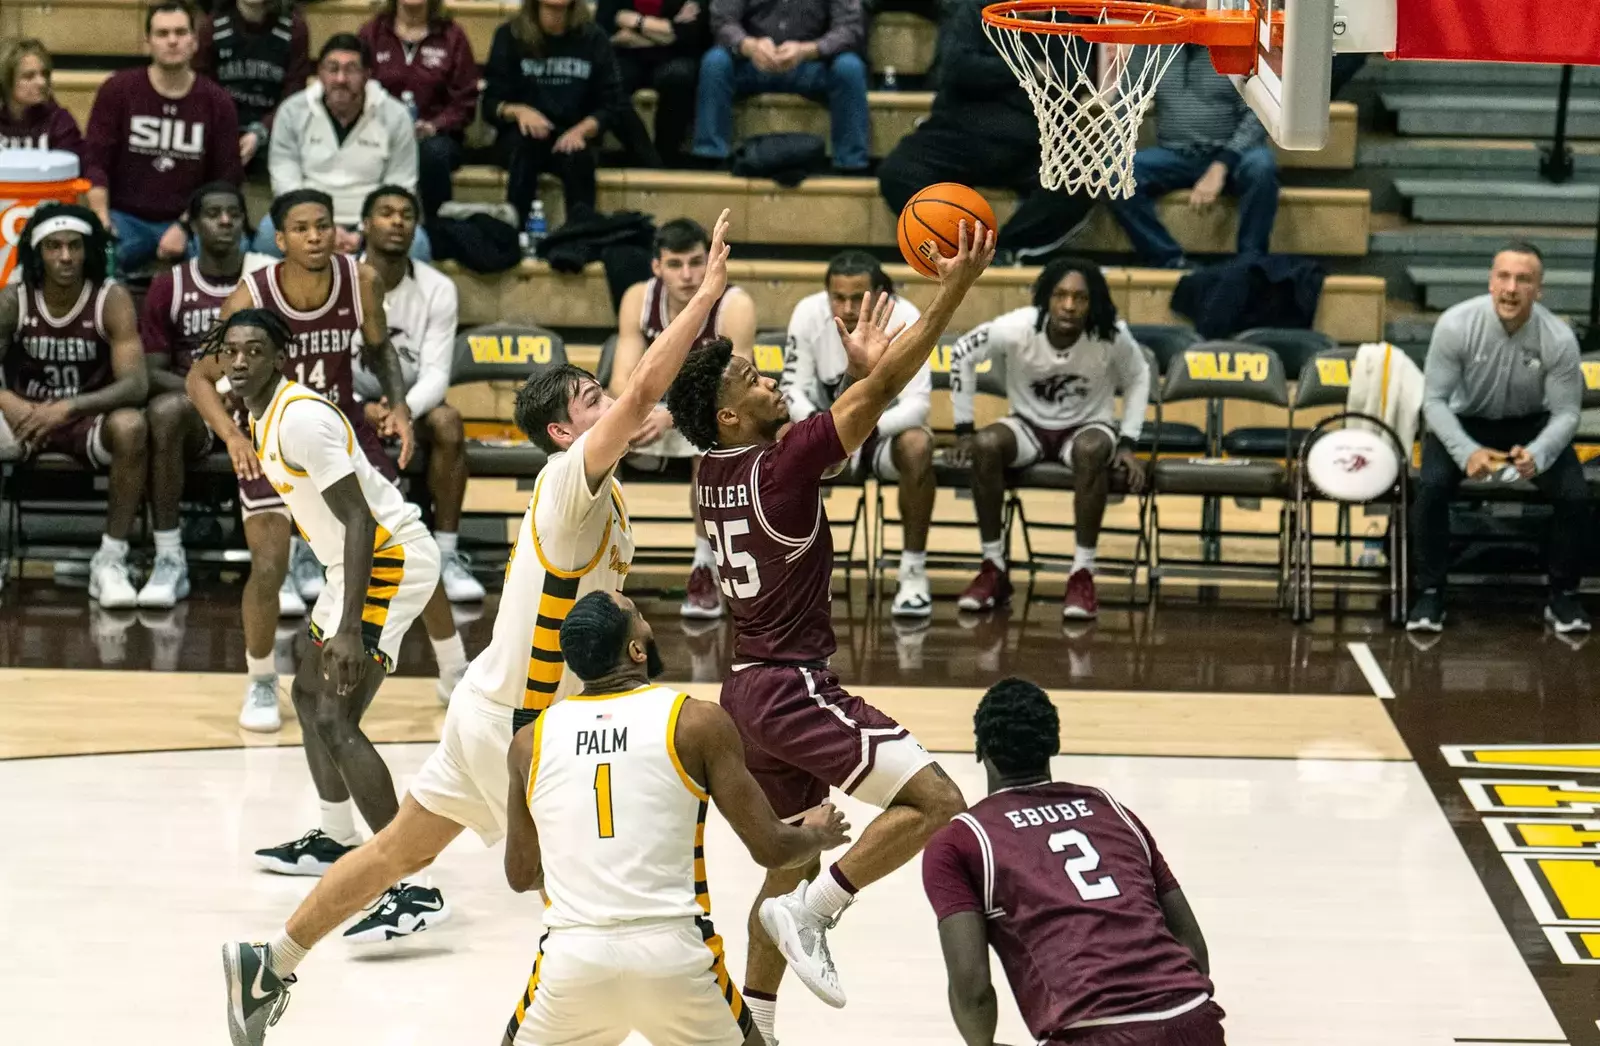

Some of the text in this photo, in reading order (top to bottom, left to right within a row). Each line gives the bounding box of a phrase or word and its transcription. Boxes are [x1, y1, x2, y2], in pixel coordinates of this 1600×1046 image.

[128, 115, 204, 153] SIU
[22, 335, 97, 361] SOUTHERN
[287, 328, 352, 358] UTHERN
[467, 336, 552, 364] VALPO
[44, 365, 80, 388] 30
[294, 359, 325, 390] 14
[1184, 352, 1269, 382] VALPO
[704, 518, 762, 599] 25
[576, 726, 628, 755] PALM
[593, 762, 615, 838] 1
[1003, 798, 1094, 829] EBUBE
[1047, 828, 1121, 901] 2
